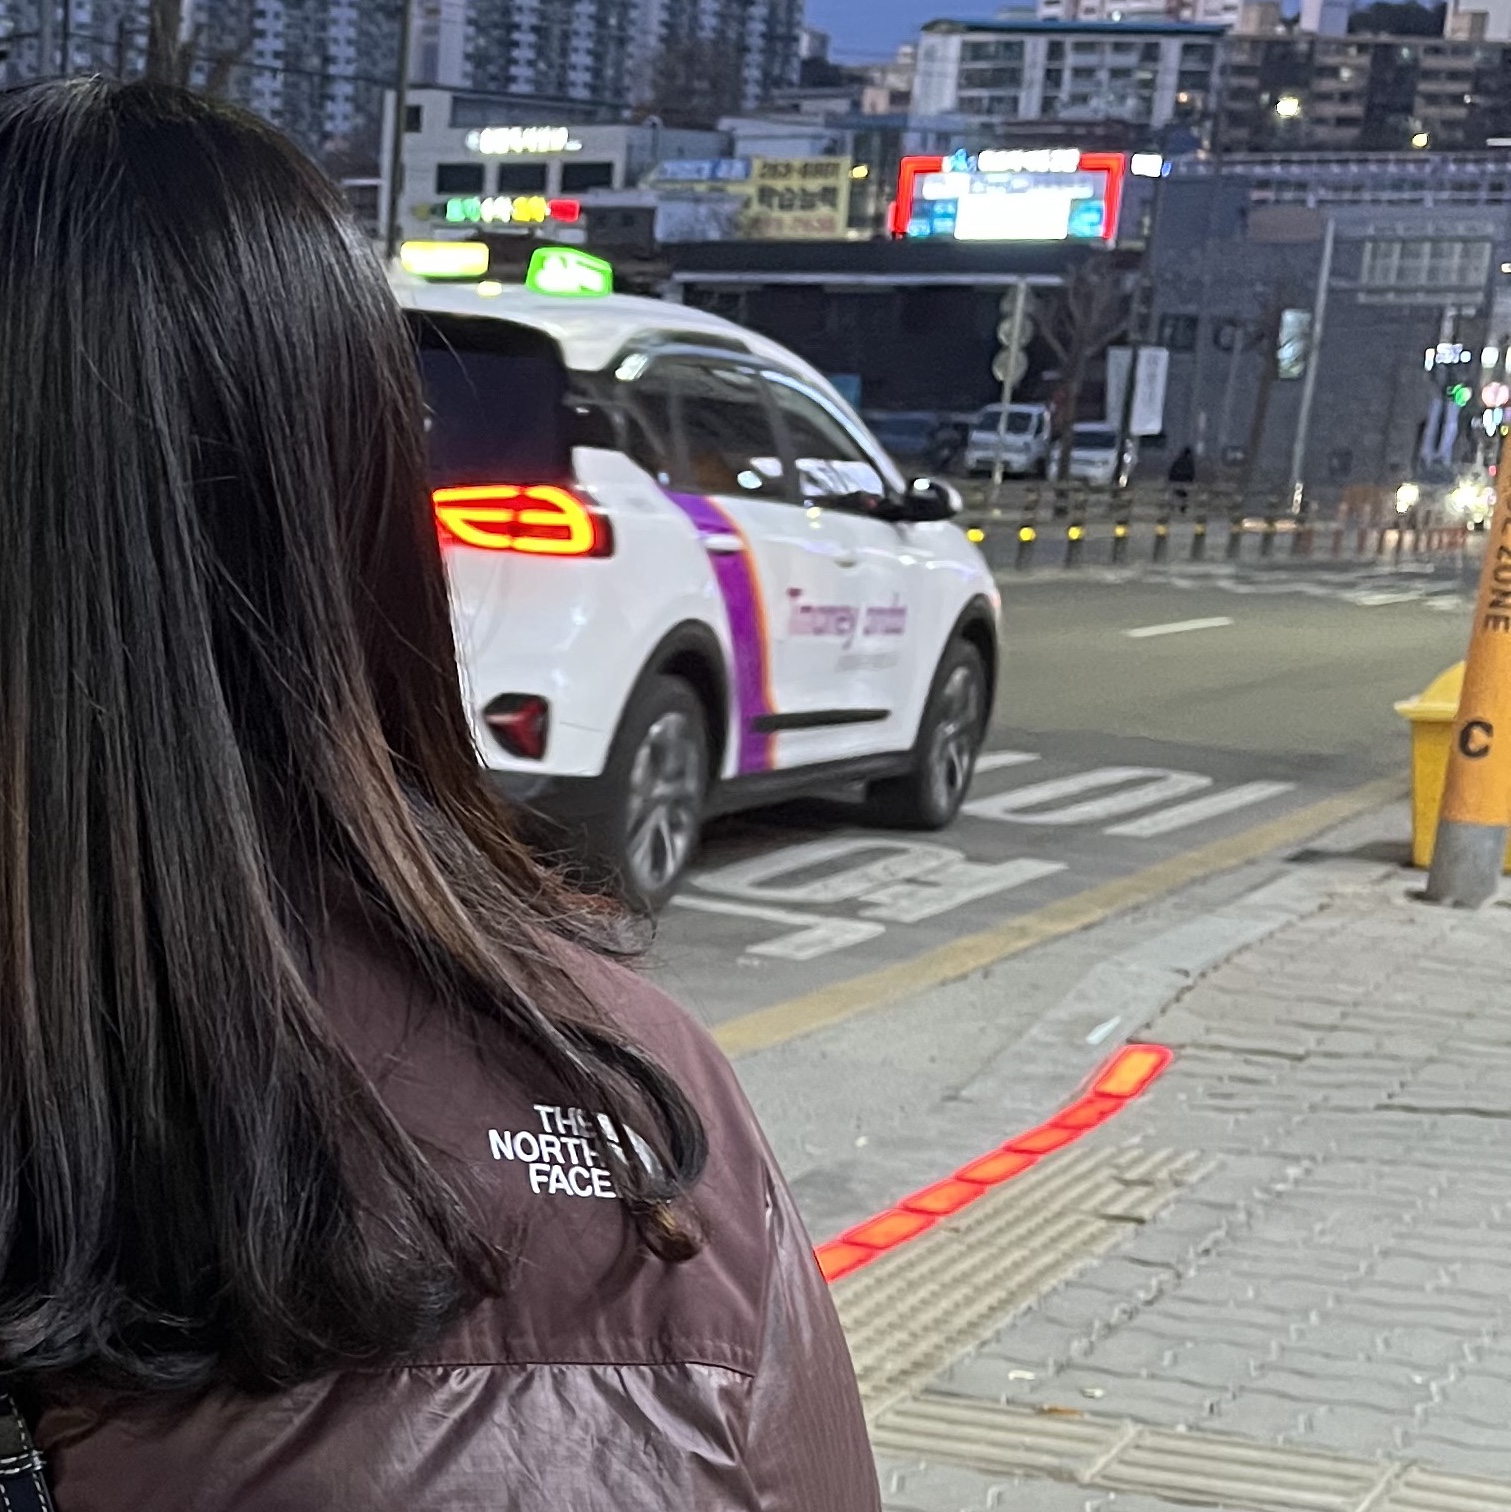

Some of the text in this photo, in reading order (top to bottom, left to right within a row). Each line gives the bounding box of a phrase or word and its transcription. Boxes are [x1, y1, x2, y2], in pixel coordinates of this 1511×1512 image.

[533, 1103, 598, 1139] THE
[488, 1128, 606, 1167] NORTH
[528, 1162, 617, 1199] FACE
